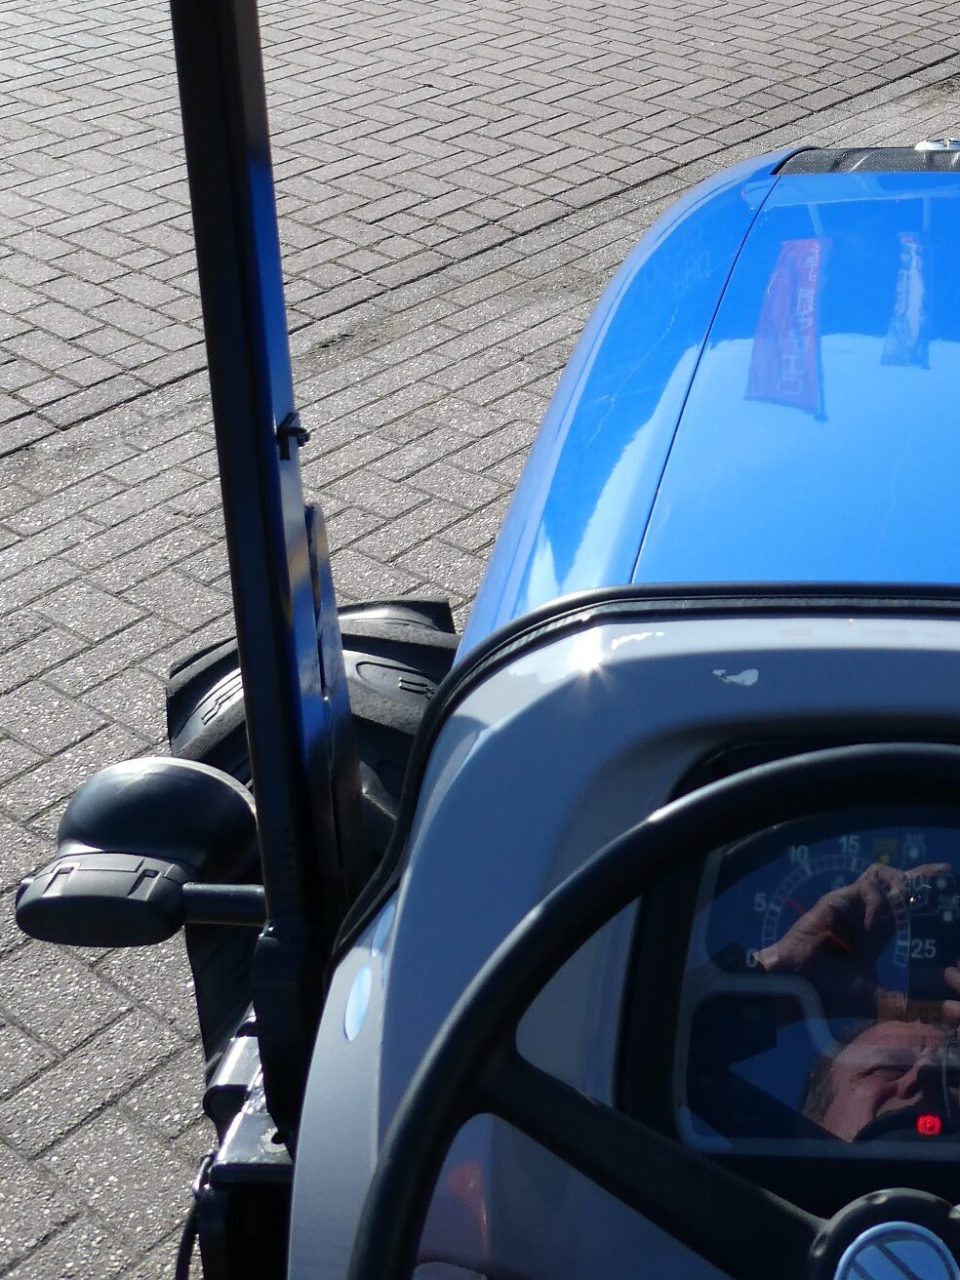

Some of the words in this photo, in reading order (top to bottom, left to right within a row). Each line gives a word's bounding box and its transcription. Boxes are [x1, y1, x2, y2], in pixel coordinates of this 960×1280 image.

[789, 844, 809, 866] 10
[839, 835, 860, 855] 15
[754, 892, 767, 912] 5
[911, 939, 937, 959] 25
